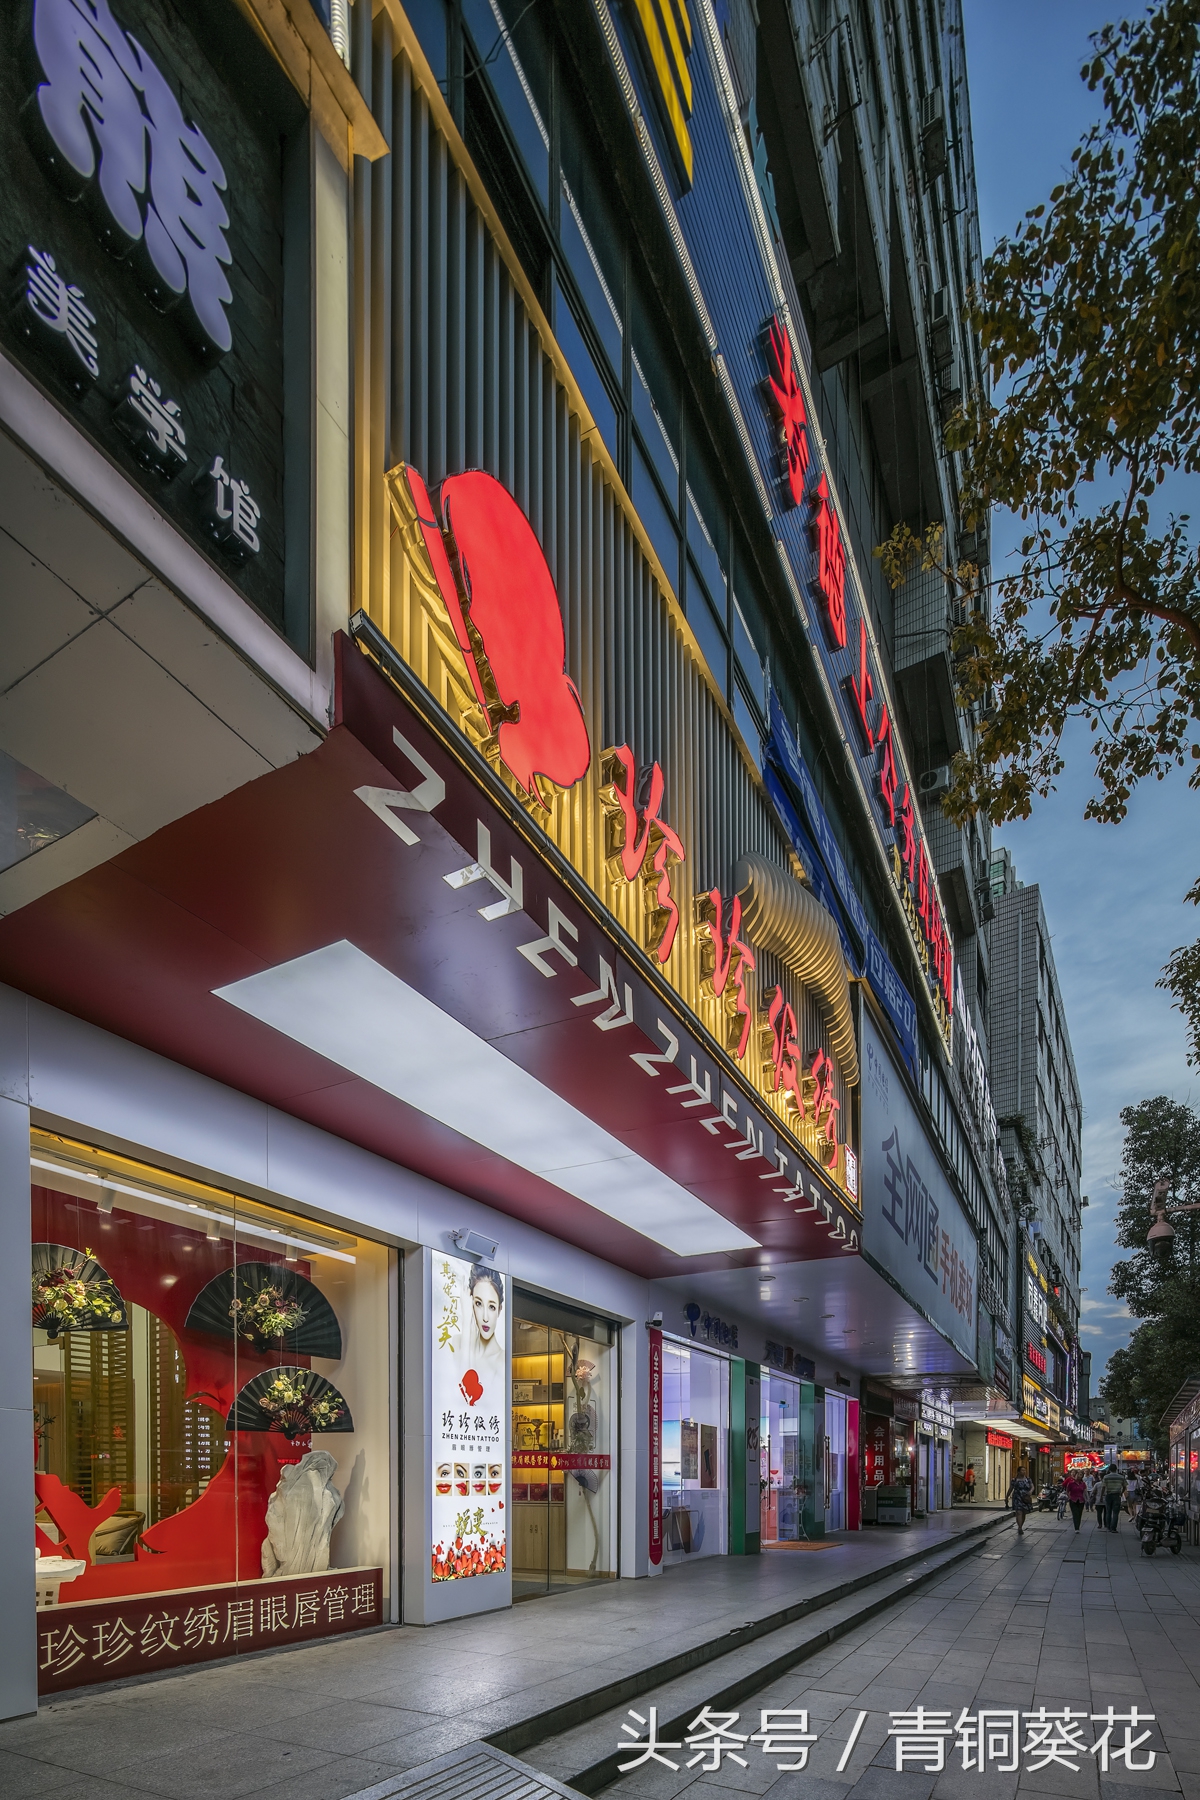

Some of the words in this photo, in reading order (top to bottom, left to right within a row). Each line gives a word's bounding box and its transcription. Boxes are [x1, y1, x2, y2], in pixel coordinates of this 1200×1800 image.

[27, 244, 260, 553] 美学馆
[873, 1426, 886, 1481] 会计用品
[39, 1581, 376, 1676] 珍珍纹绣眉眼唇管理
